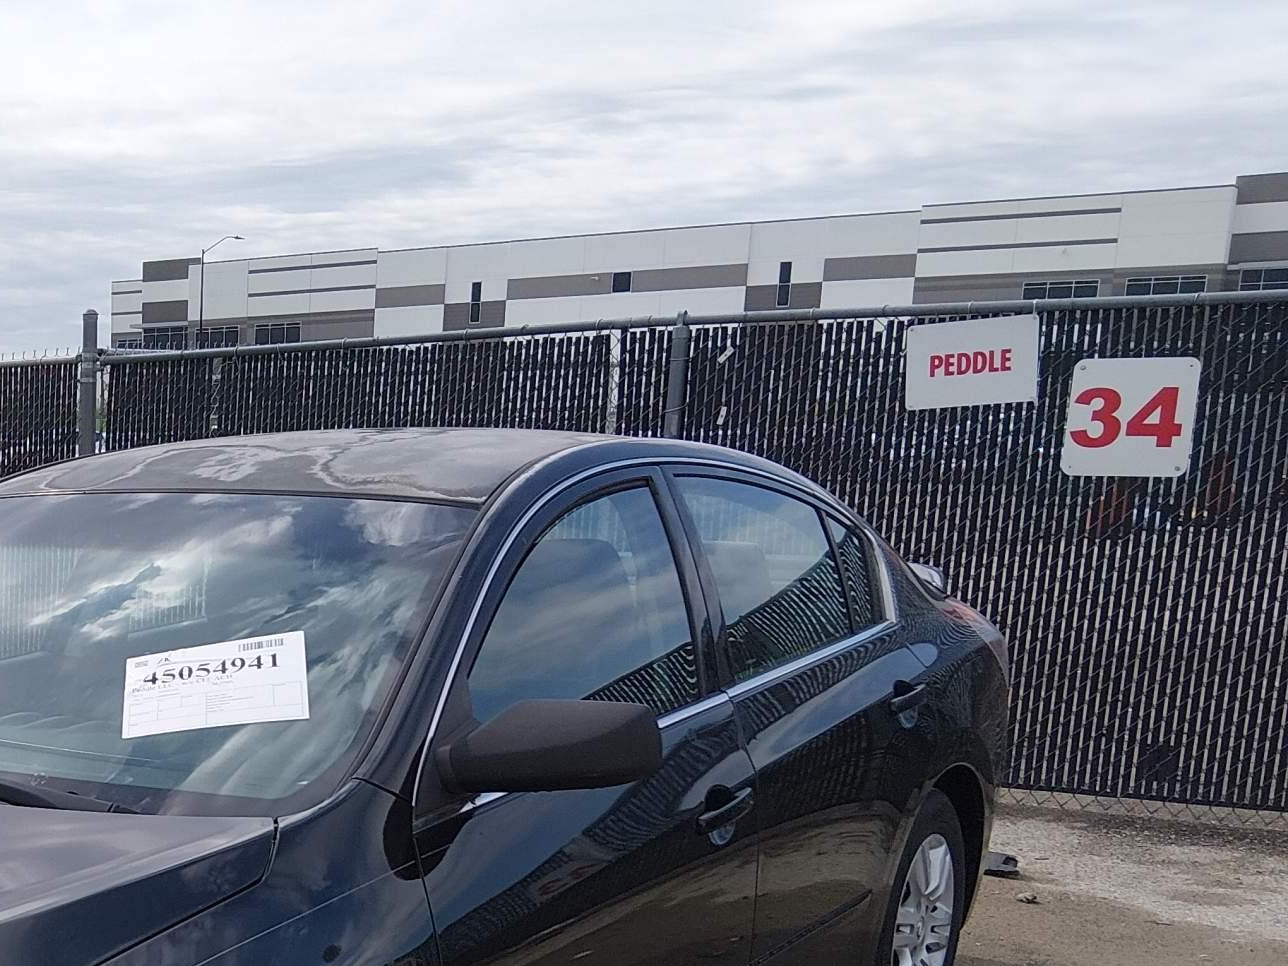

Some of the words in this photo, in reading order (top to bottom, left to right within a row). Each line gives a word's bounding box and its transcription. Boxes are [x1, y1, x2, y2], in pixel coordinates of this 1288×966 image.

[928, 348, 1013, 378] PEDDLE
[1069, 386, 1183, 448] 34
[143, 652, 281, 685] 45054941
